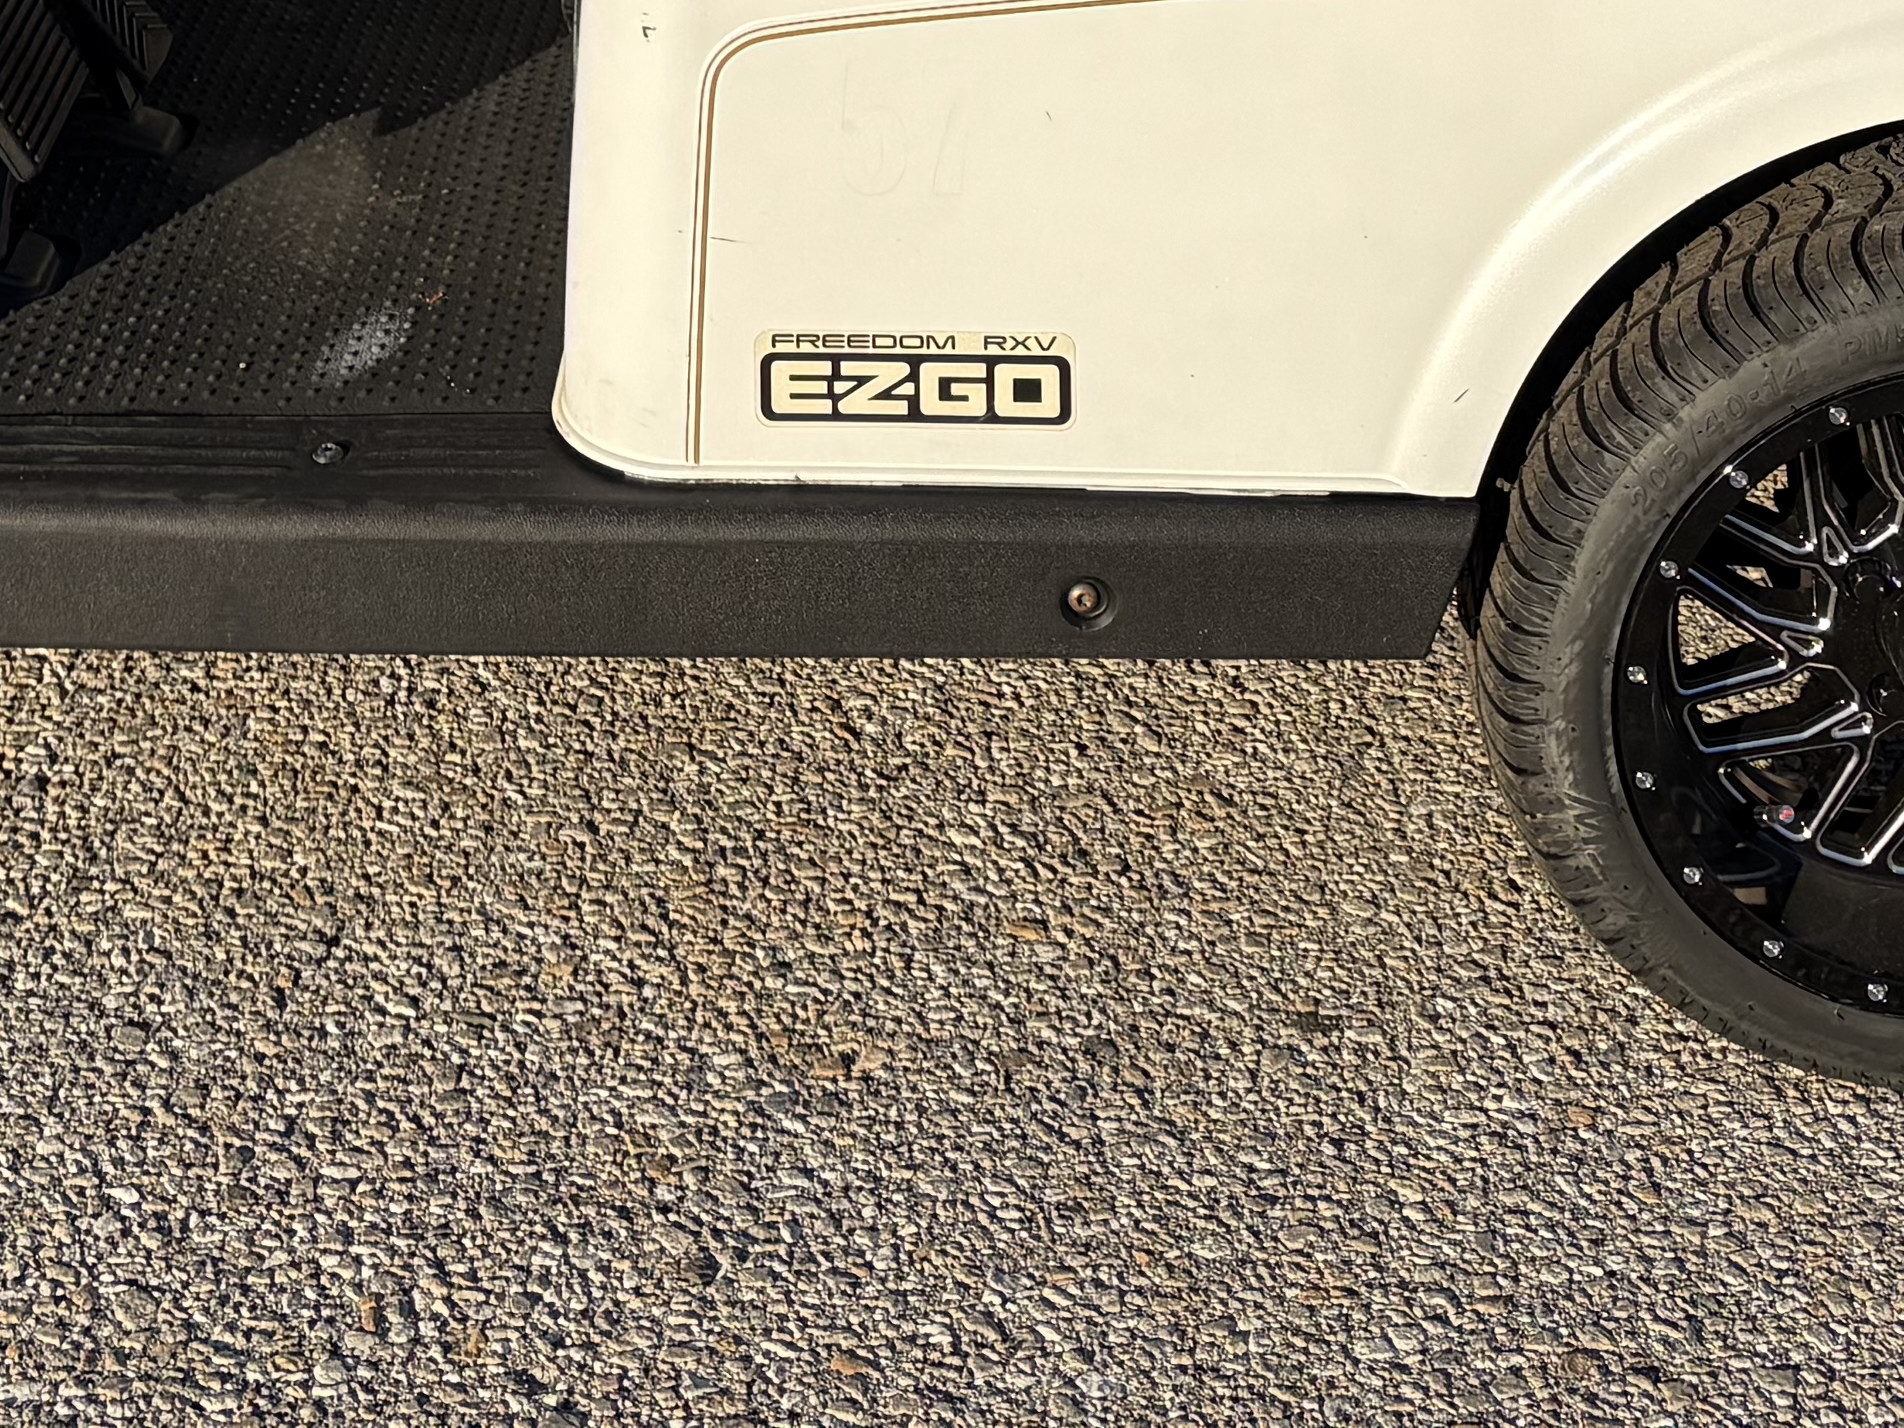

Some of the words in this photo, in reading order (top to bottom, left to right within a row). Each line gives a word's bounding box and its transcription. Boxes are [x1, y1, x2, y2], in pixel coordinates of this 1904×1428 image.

[771, 333, 956, 351] FREEDOM
[983, 335, 1057, 352] RXV
[769, 359, 1062, 419] EZGO
